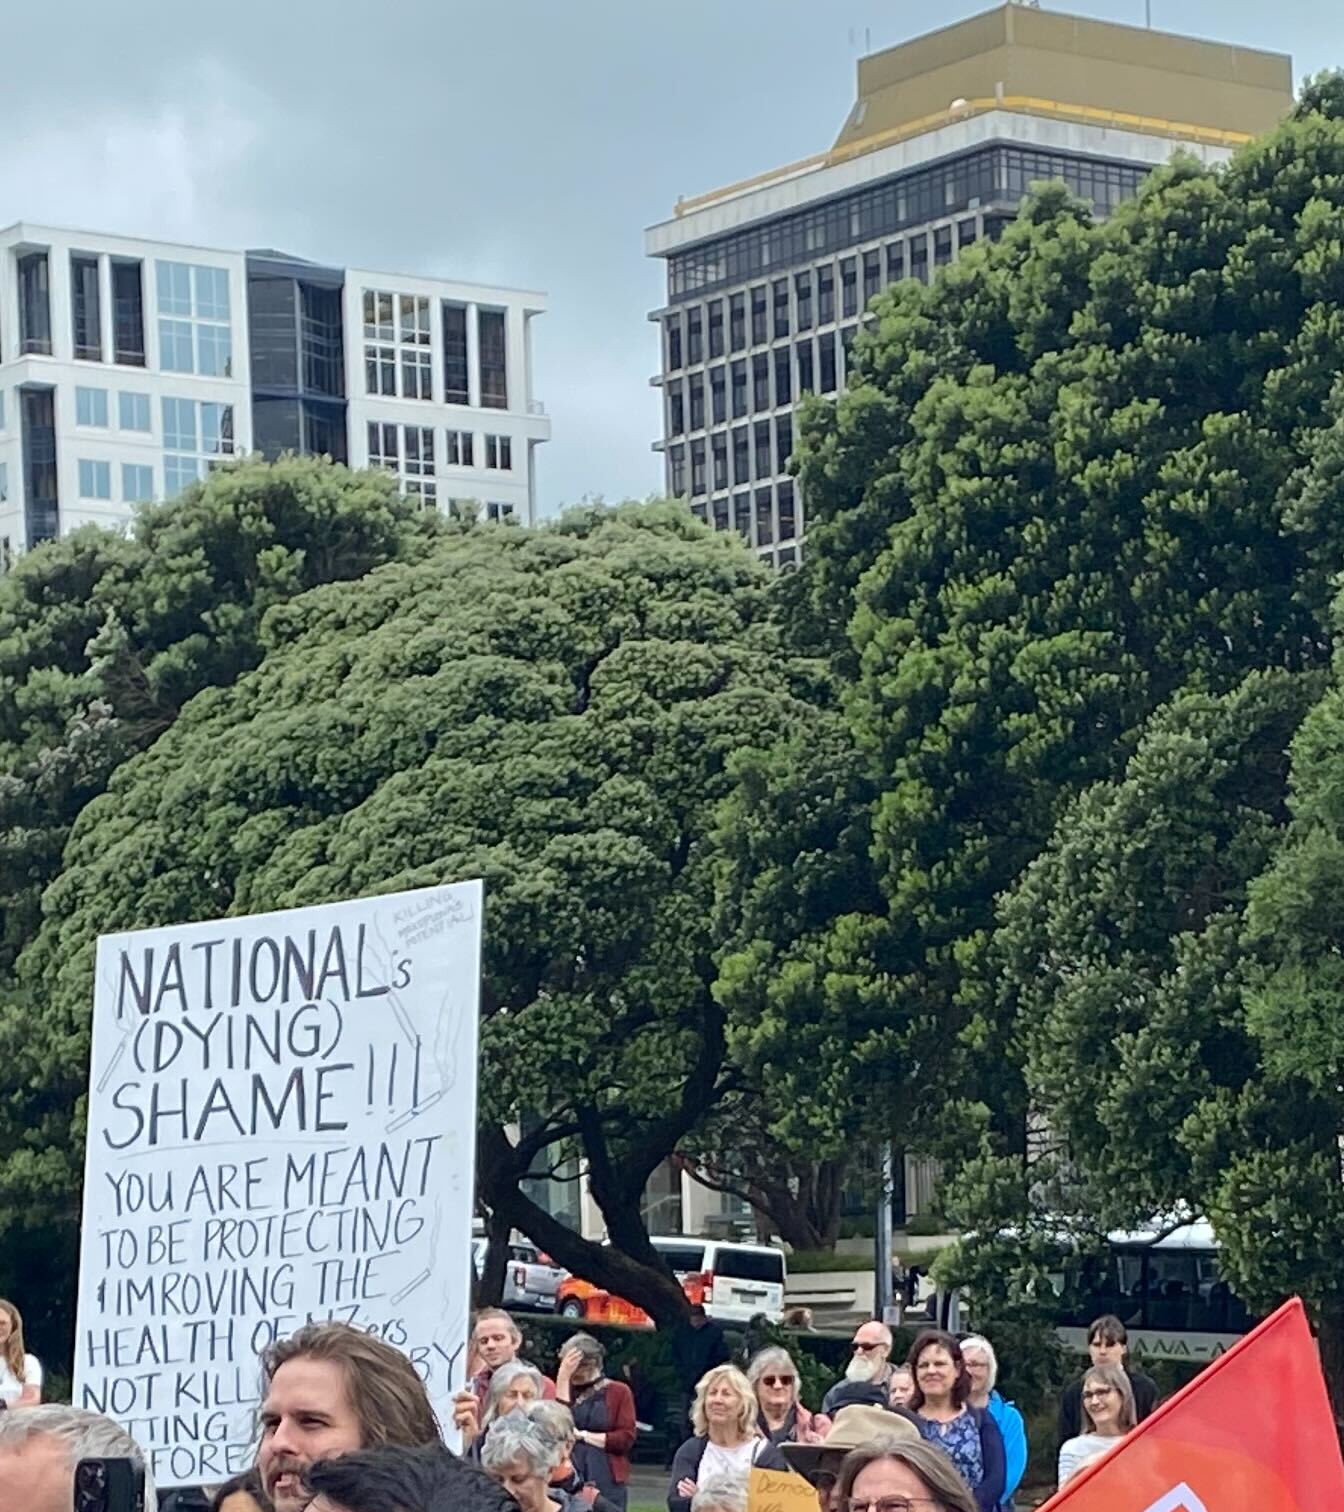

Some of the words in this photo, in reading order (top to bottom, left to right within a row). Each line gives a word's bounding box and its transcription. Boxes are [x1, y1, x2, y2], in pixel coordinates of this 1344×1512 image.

[133, 999, 344, 1074] (DYING)
[105, 1170, 174, 1217] YOU
[184, 1157, 272, 1214] ARE
[283, 1135, 443, 1209] MEANT
[100, 1229, 140, 1270] TO
[146, 1217, 193, 1265] BE
[203, 1199, 425, 1263] PROTECTING
[115, 1264, 295, 1317] IMROVING
[313, 1250, 402, 1303] THE
[87, 1318, 235, 1368] HEALTH
[250, 1314, 297, 1355] OF
[82, 1372, 163, 1415] NOT
